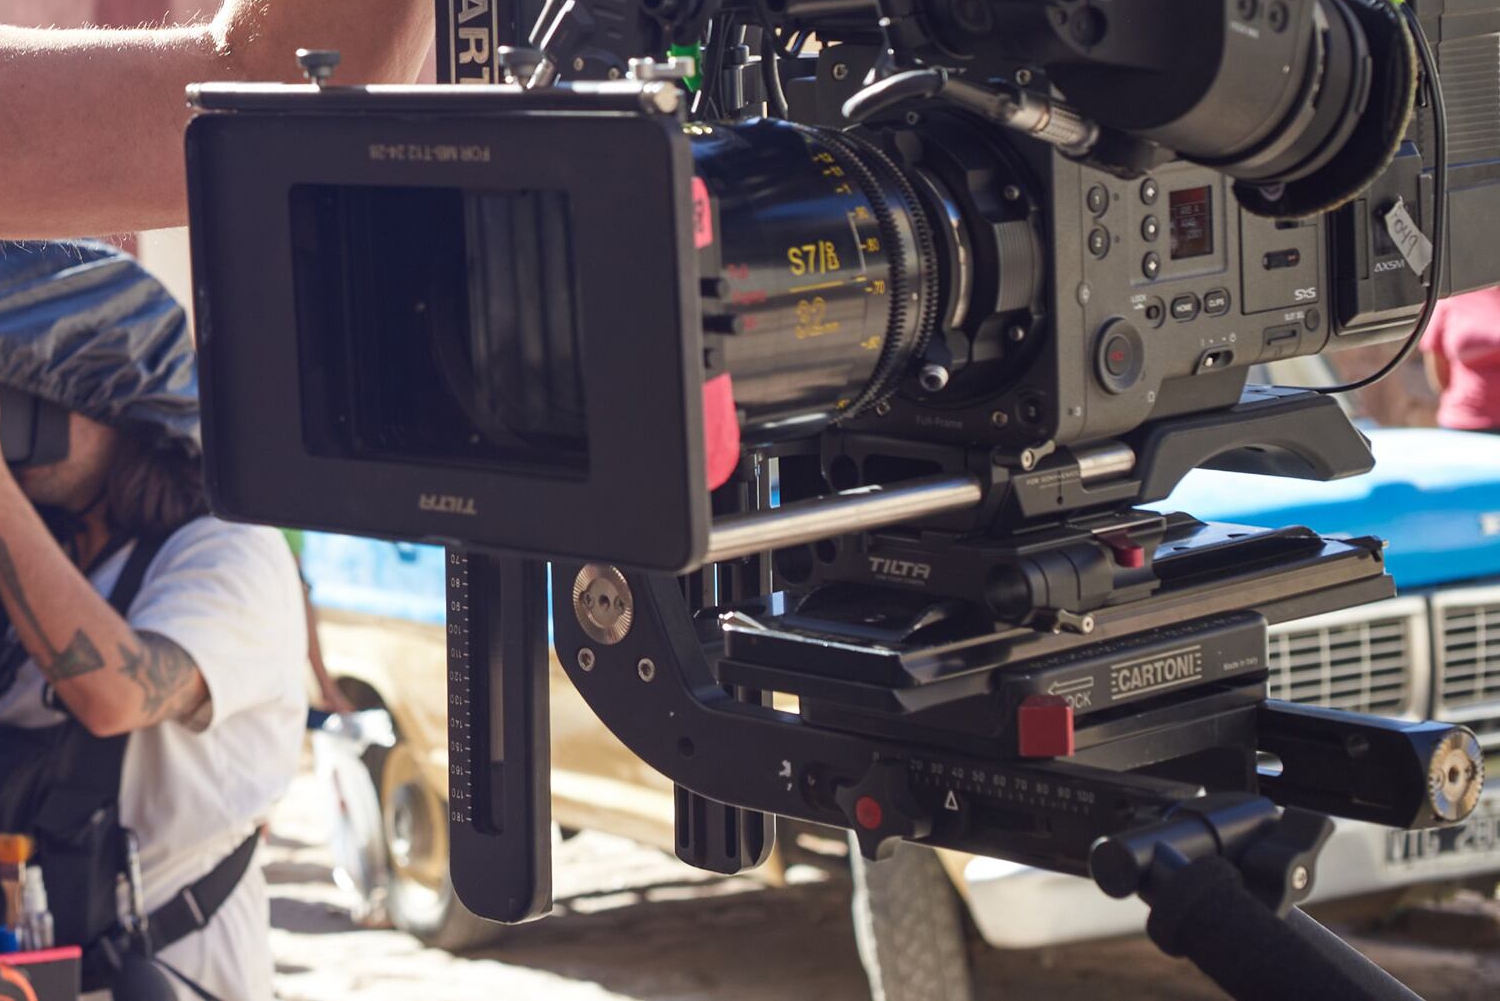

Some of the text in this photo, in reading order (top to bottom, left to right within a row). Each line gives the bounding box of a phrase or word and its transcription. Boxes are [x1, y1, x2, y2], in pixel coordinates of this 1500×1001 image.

[419, 492, 478, 516] TILTA
[451, 555, 460, 565] 70
[868, 555, 931, 580] TILTA
[451, 579, 460, 588] 80
[451, 602, 460, 612] 90
[449, 626, 461, 635] 100
[451, 650, 461, 659] 110
[450, 673, 462, 683] 120
[1118, 654, 1195, 692] CARTONI
[450, 697, 462, 706] 130
[1066, 690, 1093, 710] OCK
[450, 720, 463, 730] 140
[451, 744, 463, 753] 150
[451, 767, 463, 777] 160
[951, 767, 964, 779] 40
[972, 771, 985, 783] 50
[1015, 779, 1028, 791] 70
[1077, 791, 1095, 804] 100
[451, 791, 463, 800] 170
[451, 814, 463, 824] 180
